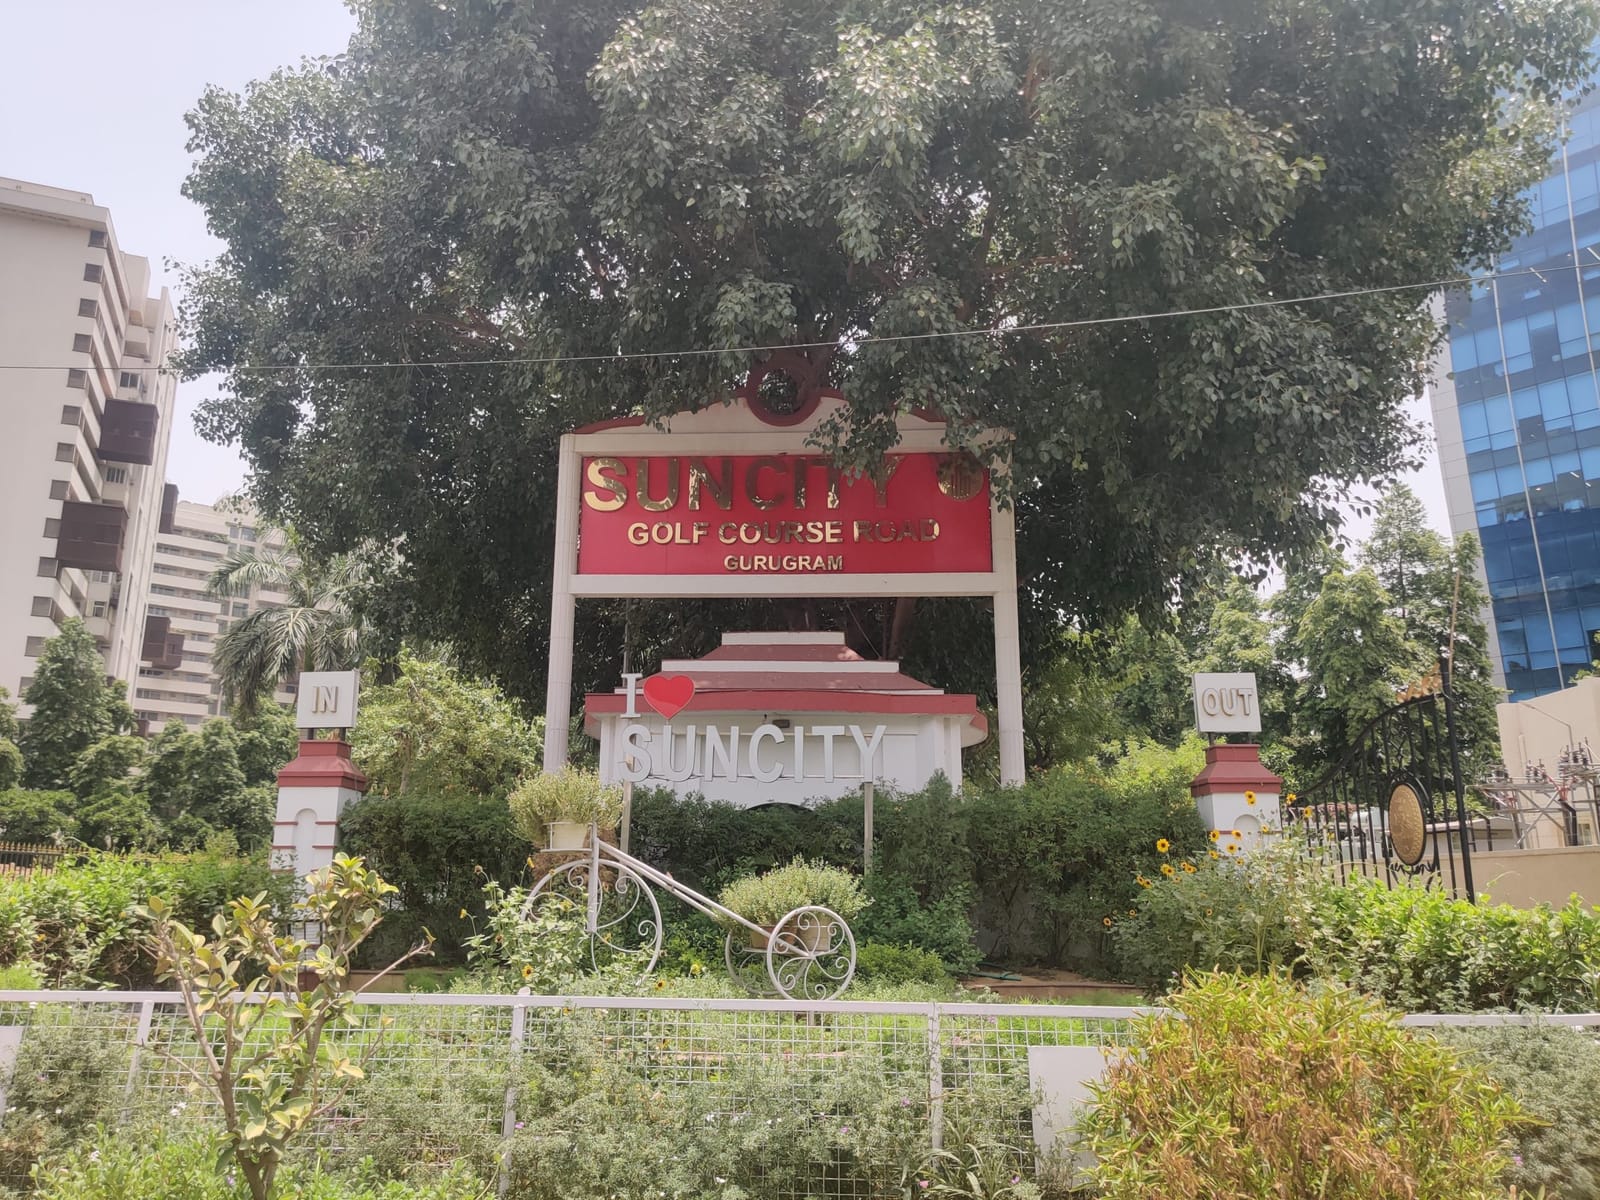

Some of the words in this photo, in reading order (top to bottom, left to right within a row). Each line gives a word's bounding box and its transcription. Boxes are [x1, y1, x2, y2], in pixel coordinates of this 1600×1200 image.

[583, 456, 905, 512] SUNCITY
[627, 521, 710, 545] GOLF
[718, 520, 844, 545] COURSE
[853, 518, 941, 543] ROAD
[723, 554, 844, 572] GURUGRAM
[312, 685, 338, 713] IN
[620, 672, 643, 718] I
[1202, 688, 1254, 717] OUT
[620, 724, 887, 783] SUNCITY
